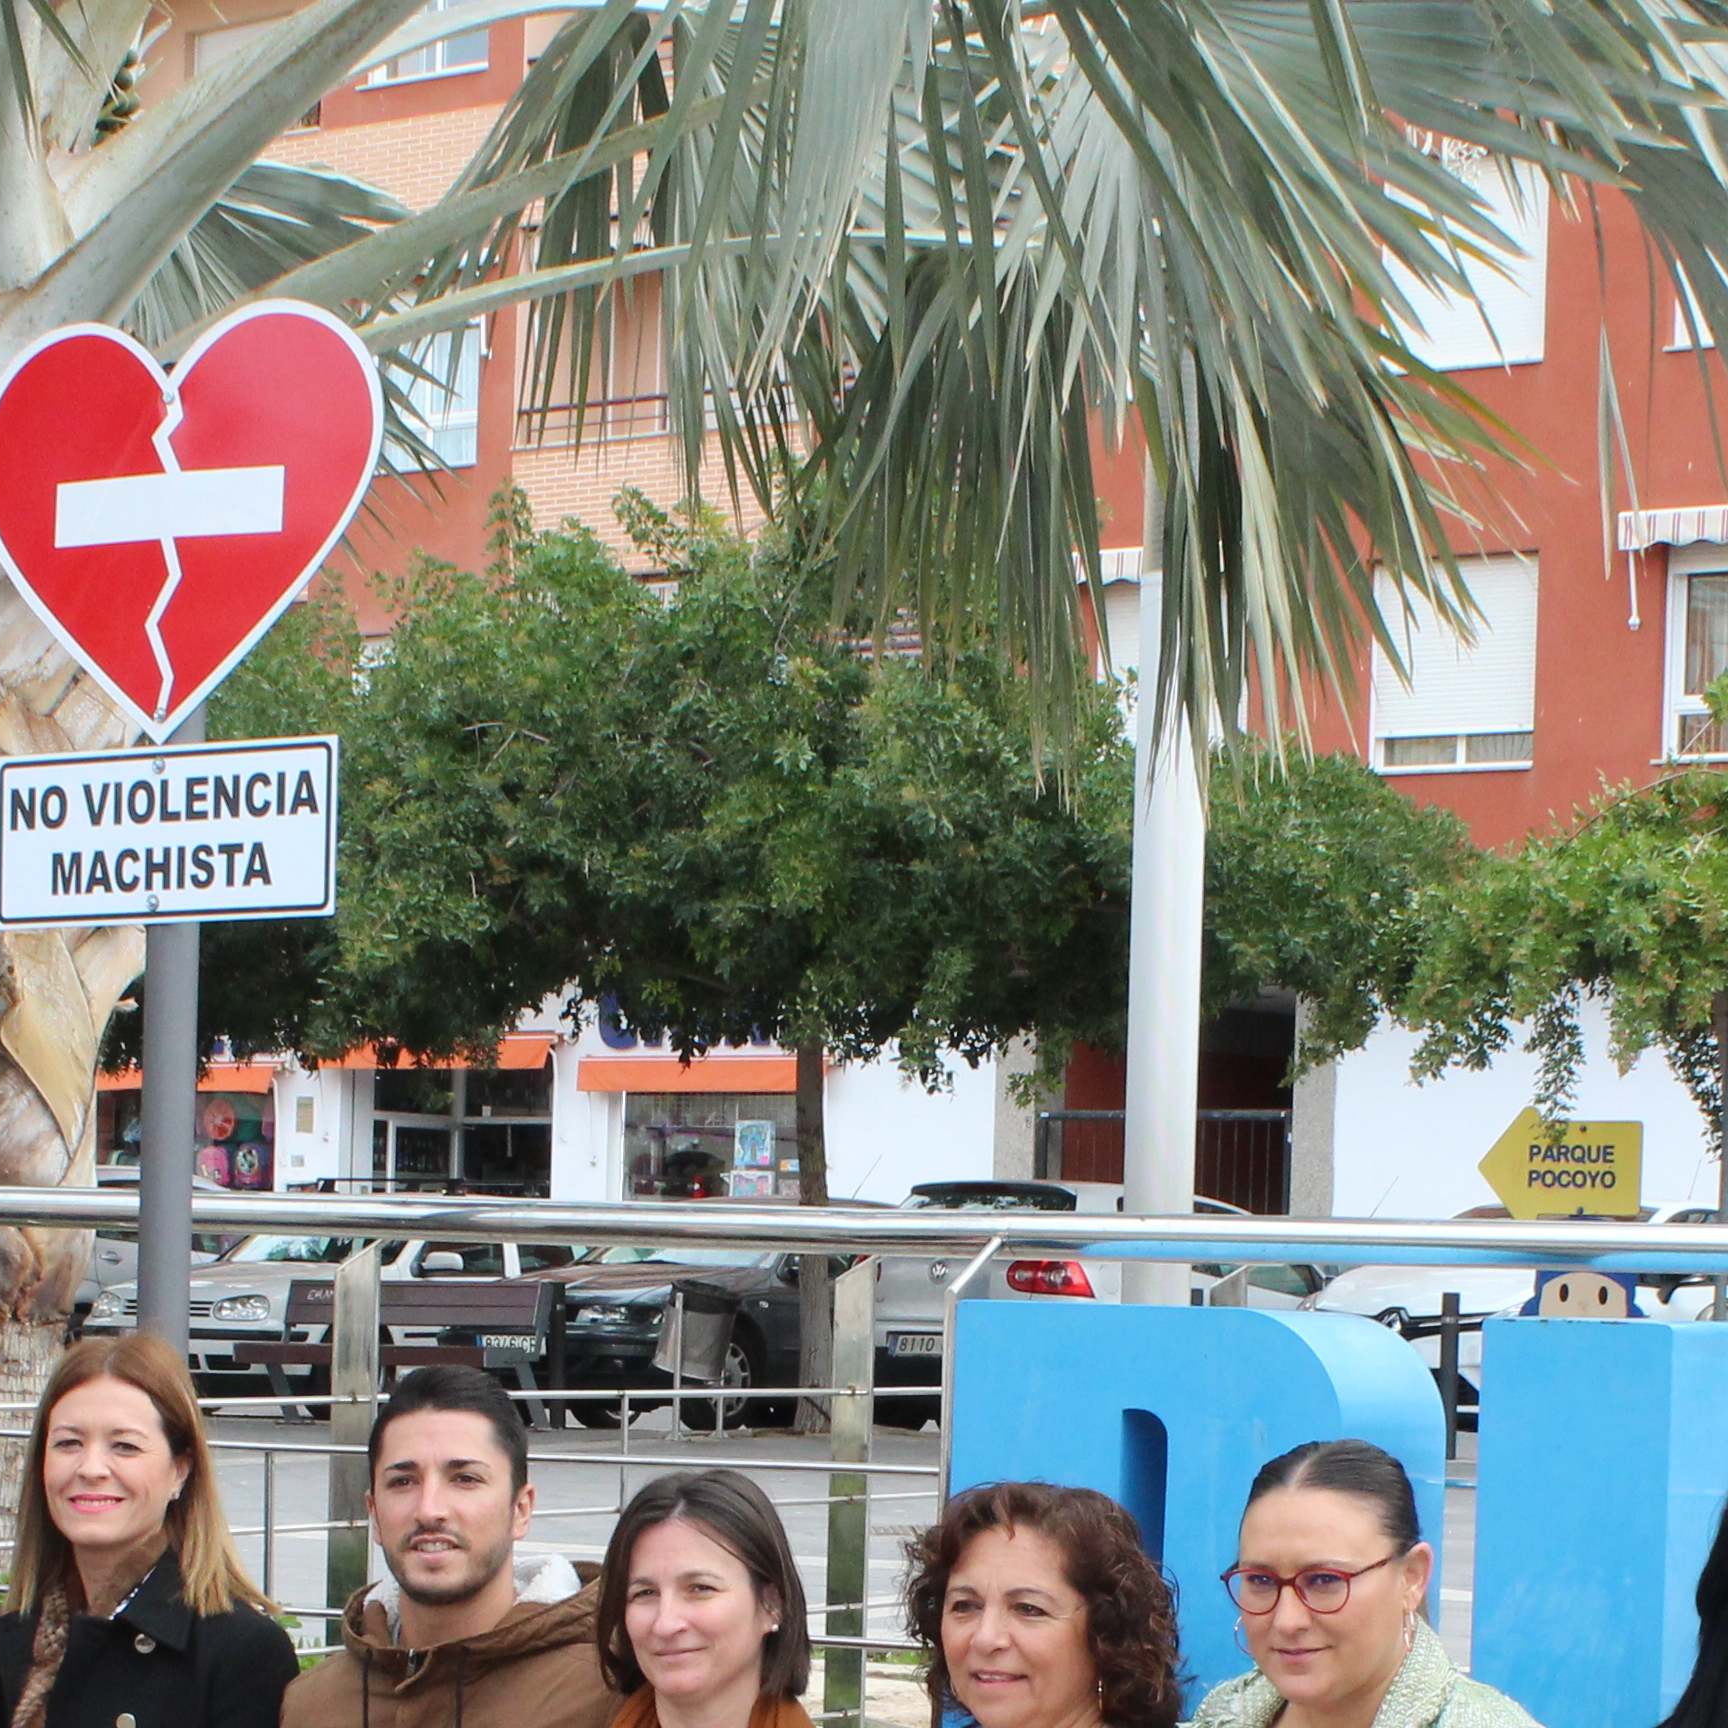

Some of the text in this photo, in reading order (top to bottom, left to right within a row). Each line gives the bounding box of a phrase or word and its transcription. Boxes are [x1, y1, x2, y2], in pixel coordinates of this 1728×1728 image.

[8, 769, 319, 834] NO VIOLENCIA
[50, 841, 273, 897] MACHISTA
[1528, 1144, 1615, 1164] PARQUE
[899, 1336, 935, 1352] 8110
